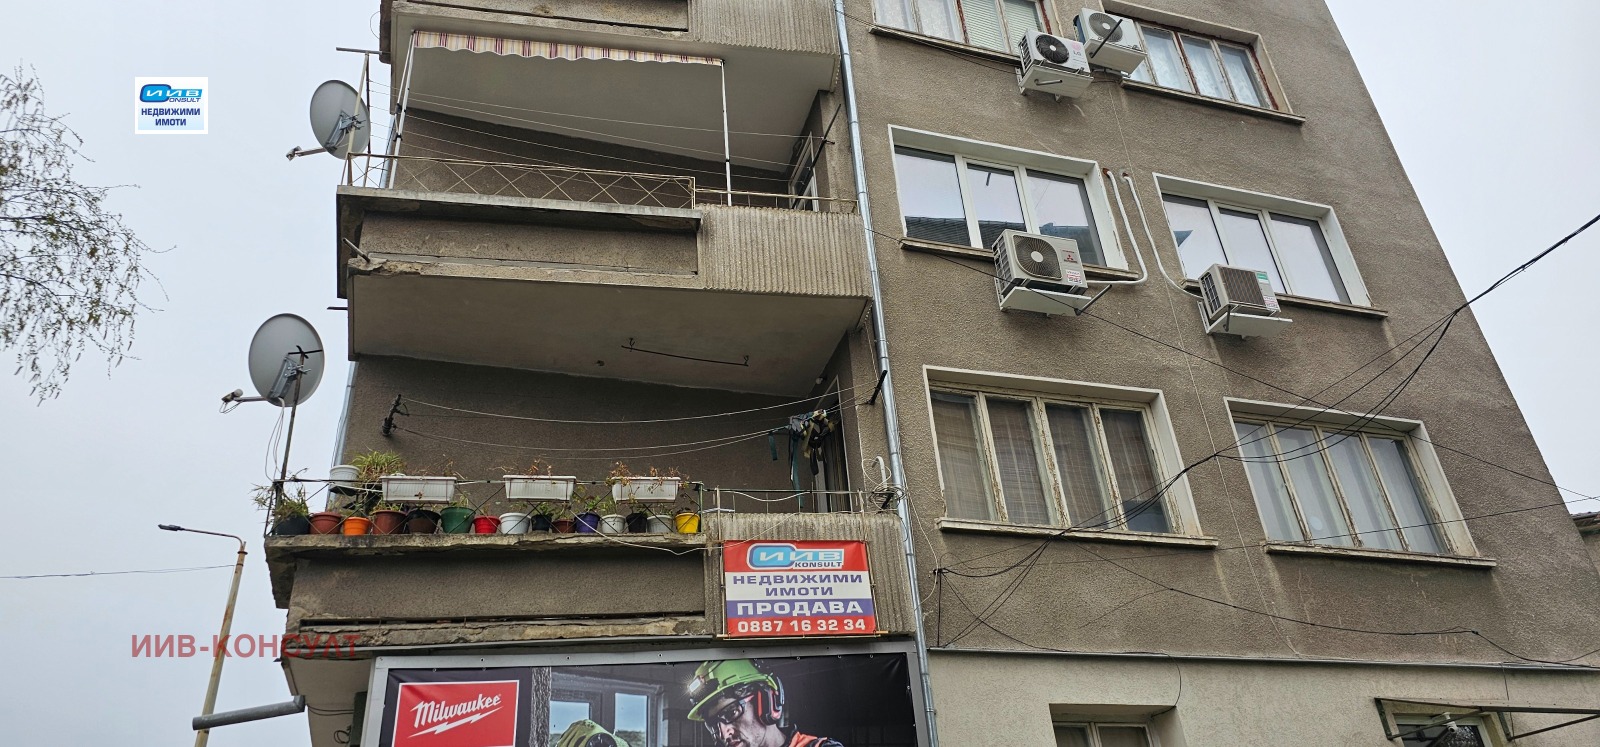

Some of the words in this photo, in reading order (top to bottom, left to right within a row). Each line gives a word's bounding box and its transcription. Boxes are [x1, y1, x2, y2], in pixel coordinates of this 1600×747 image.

[759, 551, 841, 561] ИИВ
[732, 574, 863, 586] НЕДВИЖИМИ
[765, 586, 834, 597] ИМОТИ
[736, 601, 864, 617] ПРОДАВА
[737, 620, 783, 633] 0887
[789, 620, 812, 632] 16
[817, 619, 839, 632] 32
[843, 618, 866, 631] 34
[409, 693, 502, 729] Milwaukee
